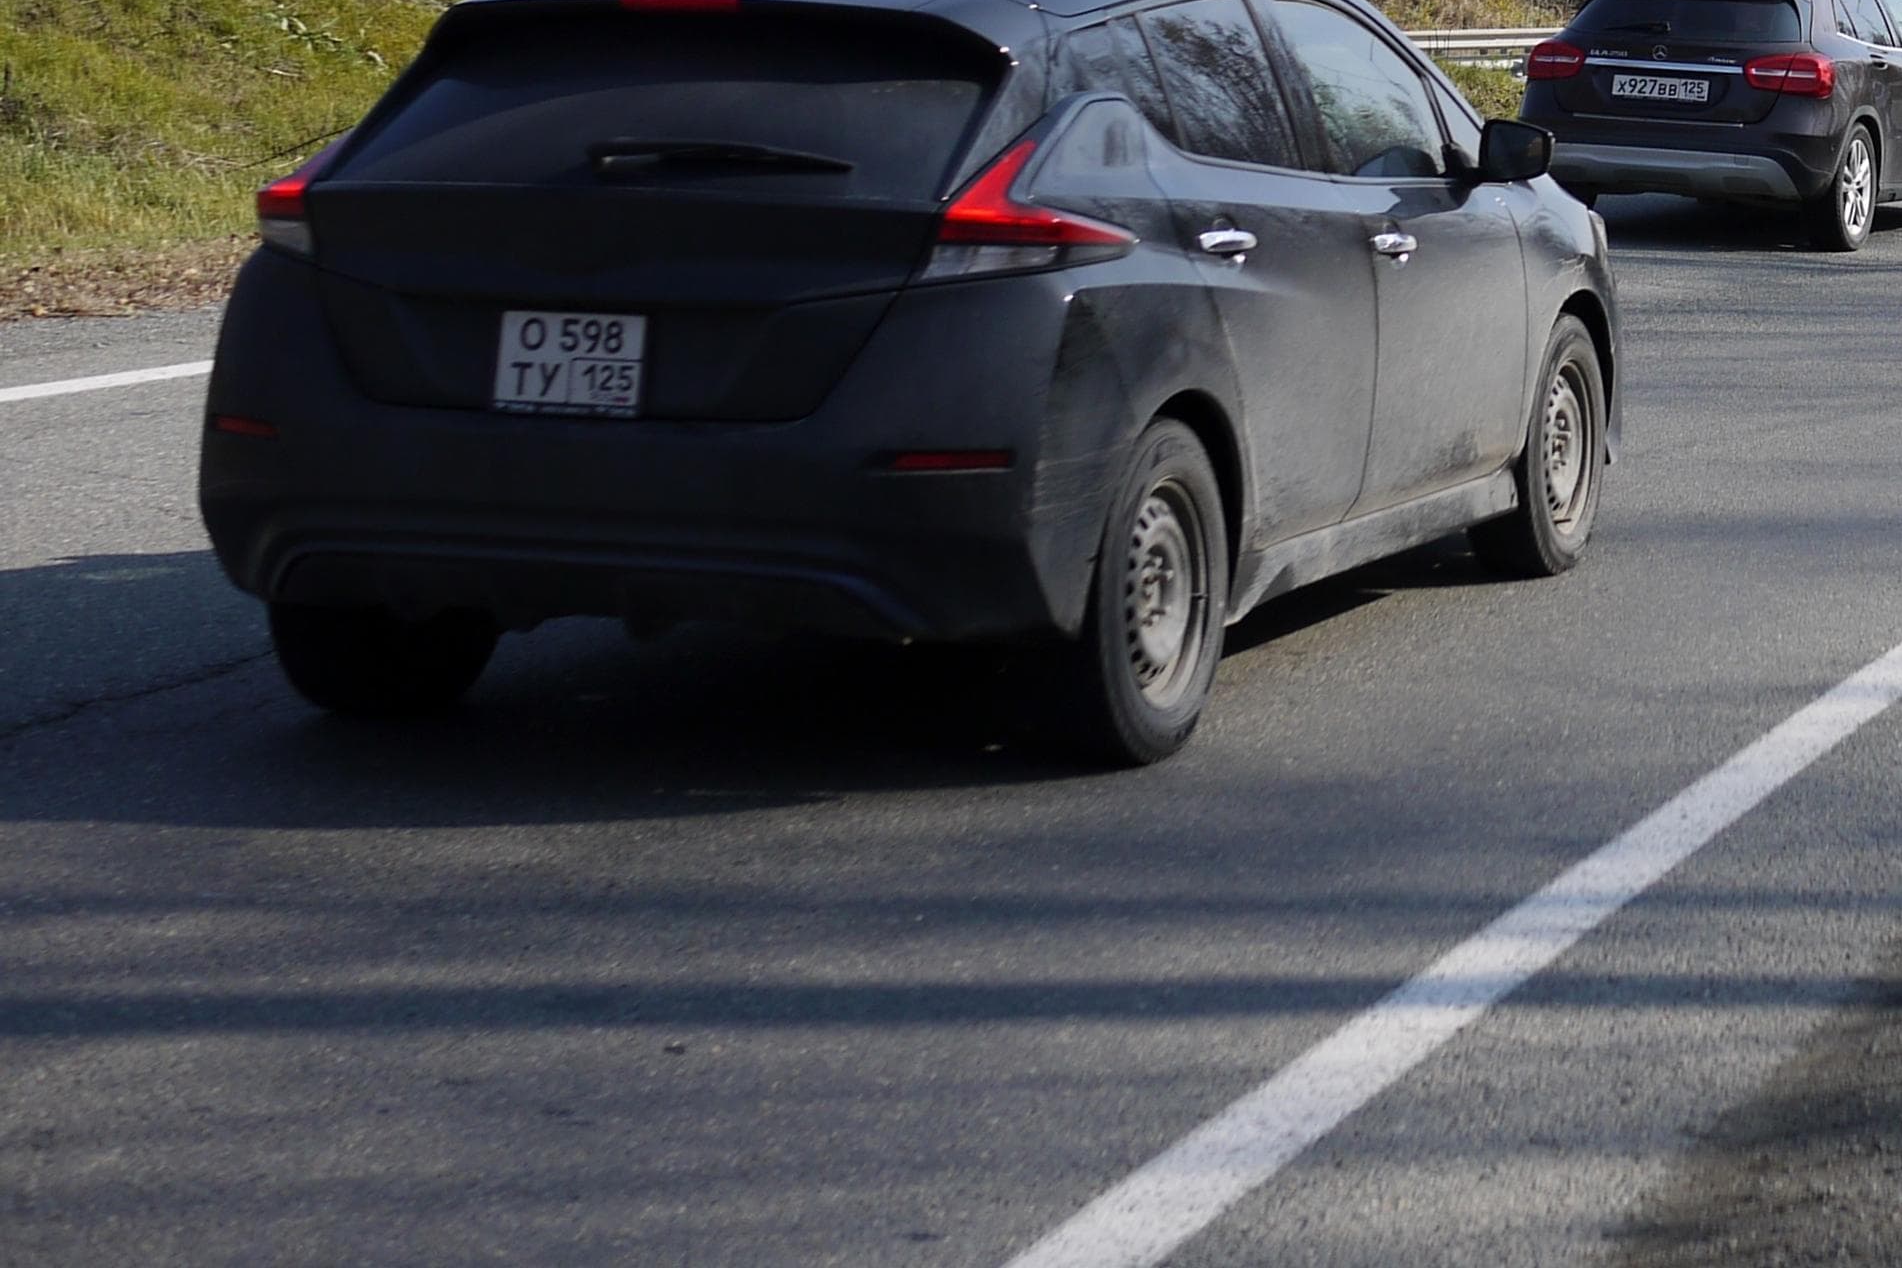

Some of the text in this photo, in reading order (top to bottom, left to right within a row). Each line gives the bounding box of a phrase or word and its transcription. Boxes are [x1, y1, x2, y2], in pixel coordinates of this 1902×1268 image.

[1617, 78, 1705, 97] Х927ВВ 125
[558, 318, 624, 354] 598
[510, 361, 634, 397] ТУ 125
